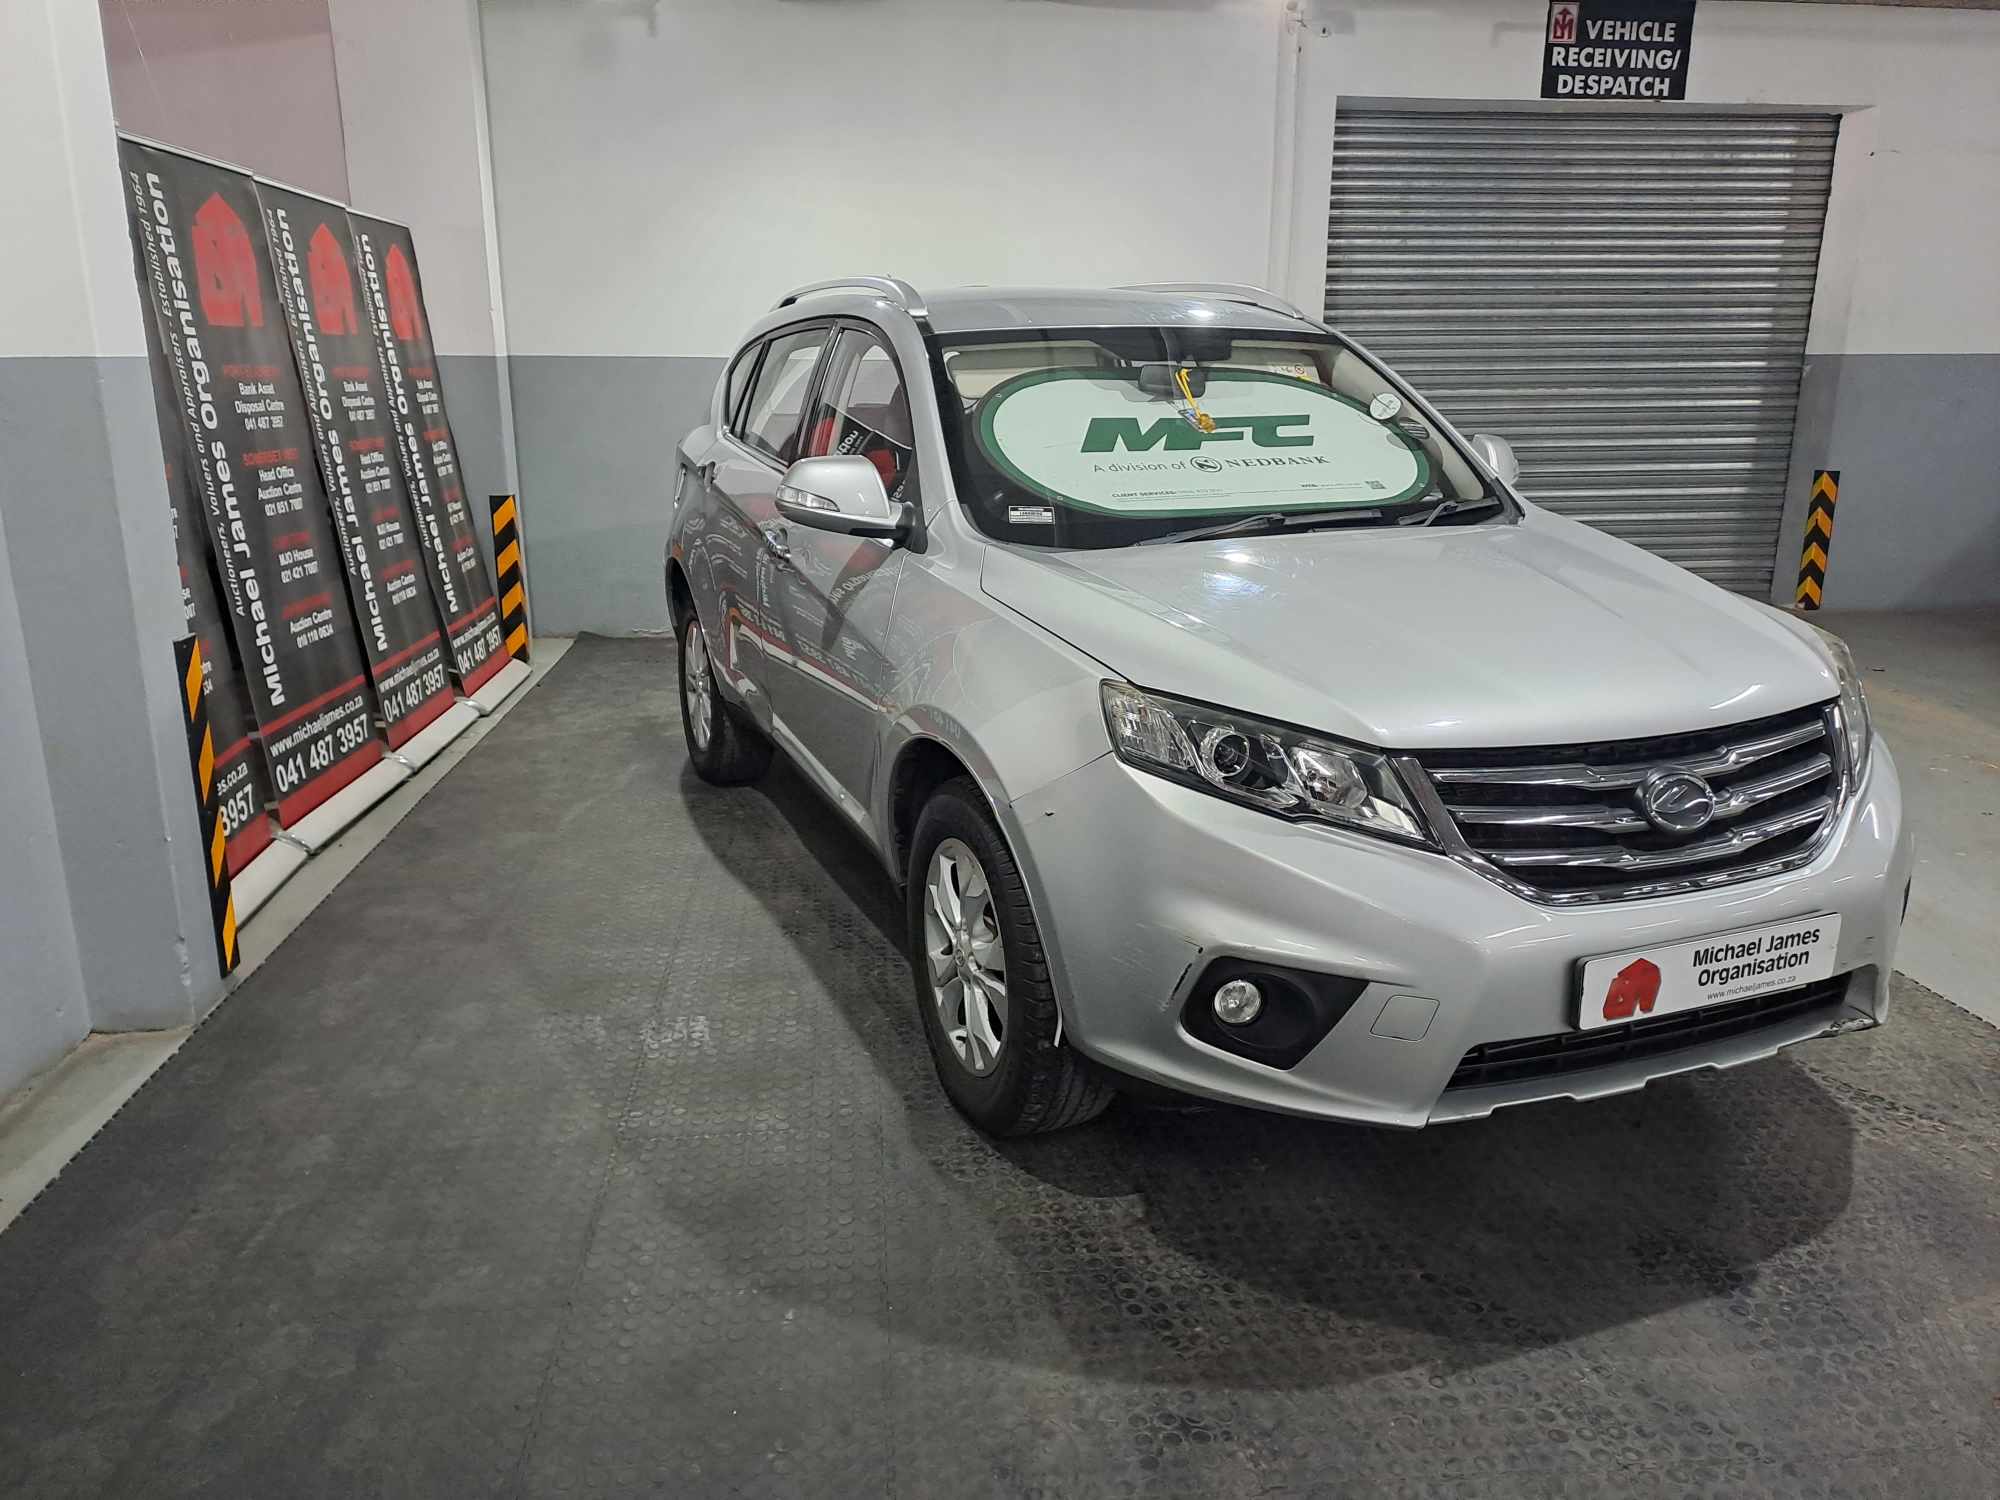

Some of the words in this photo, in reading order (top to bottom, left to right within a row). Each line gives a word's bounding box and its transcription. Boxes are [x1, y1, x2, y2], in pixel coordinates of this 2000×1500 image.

[1551, 47, 1681, 70] RECEIVING/
[1586, 20, 1677, 42] VEHICLE
[1557, 75, 1670, 96] DESPATCH
[130, 171, 148, 214] 1964
[139, 219, 172, 317] Established
[274, 247, 298, 327] Established
[146, 172, 218, 430] Organisation
[276, 208, 333, 420] Organisation
[361, 234, 409, 415] Organisation
[169, 332, 196, 419] Appraisers
[295, 338, 318, 412] Appraisers
[189, 421, 205, 453] and
[313, 413, 325, 440] and
[1081, 414, 1314, 453] MFC
[200, 458, 220, 516] Valuers
[320, 445, 337, 492] Valuers
[328, 430, 360, 528] James
[405, 422, 432, 507] James
[1093, 464, 1102, 473] A
[1107, 460, 1167, 473] division
[1170, 461, 1188, 472] of
[1226, 456, 1330, 469] NEDBANK
[210, 440, 251, 559] James
[217, 522, 245, 617] Auctioneers,
[351, 536, 388, 651] Michael
[425, 514, 459, 613] Michael
[239, 568, 286, 706] Michael
[457, 647, 475, 674] 041
[473, 637, 487, 661] 487
[383, 691, 406, 723] 041
[405, 678, 423, 707] 487
[422, 663, 446, 695] 3957
[269, 695, 364, 758] www.michaeljames.co.za
[275, 752, 306, 793] 041
[309, 734, 335, 771] 487
[336, 713, 369, 753] 3957
[220, 783, 255, 837] 3957
[1692, 937, 1762, 968] Michael
[1765, 928, 1820, 953] James
[1697, 950, 1809, 987] Organisation
[1707, 974, 1796, 1000] www.michaeljames.co.za
